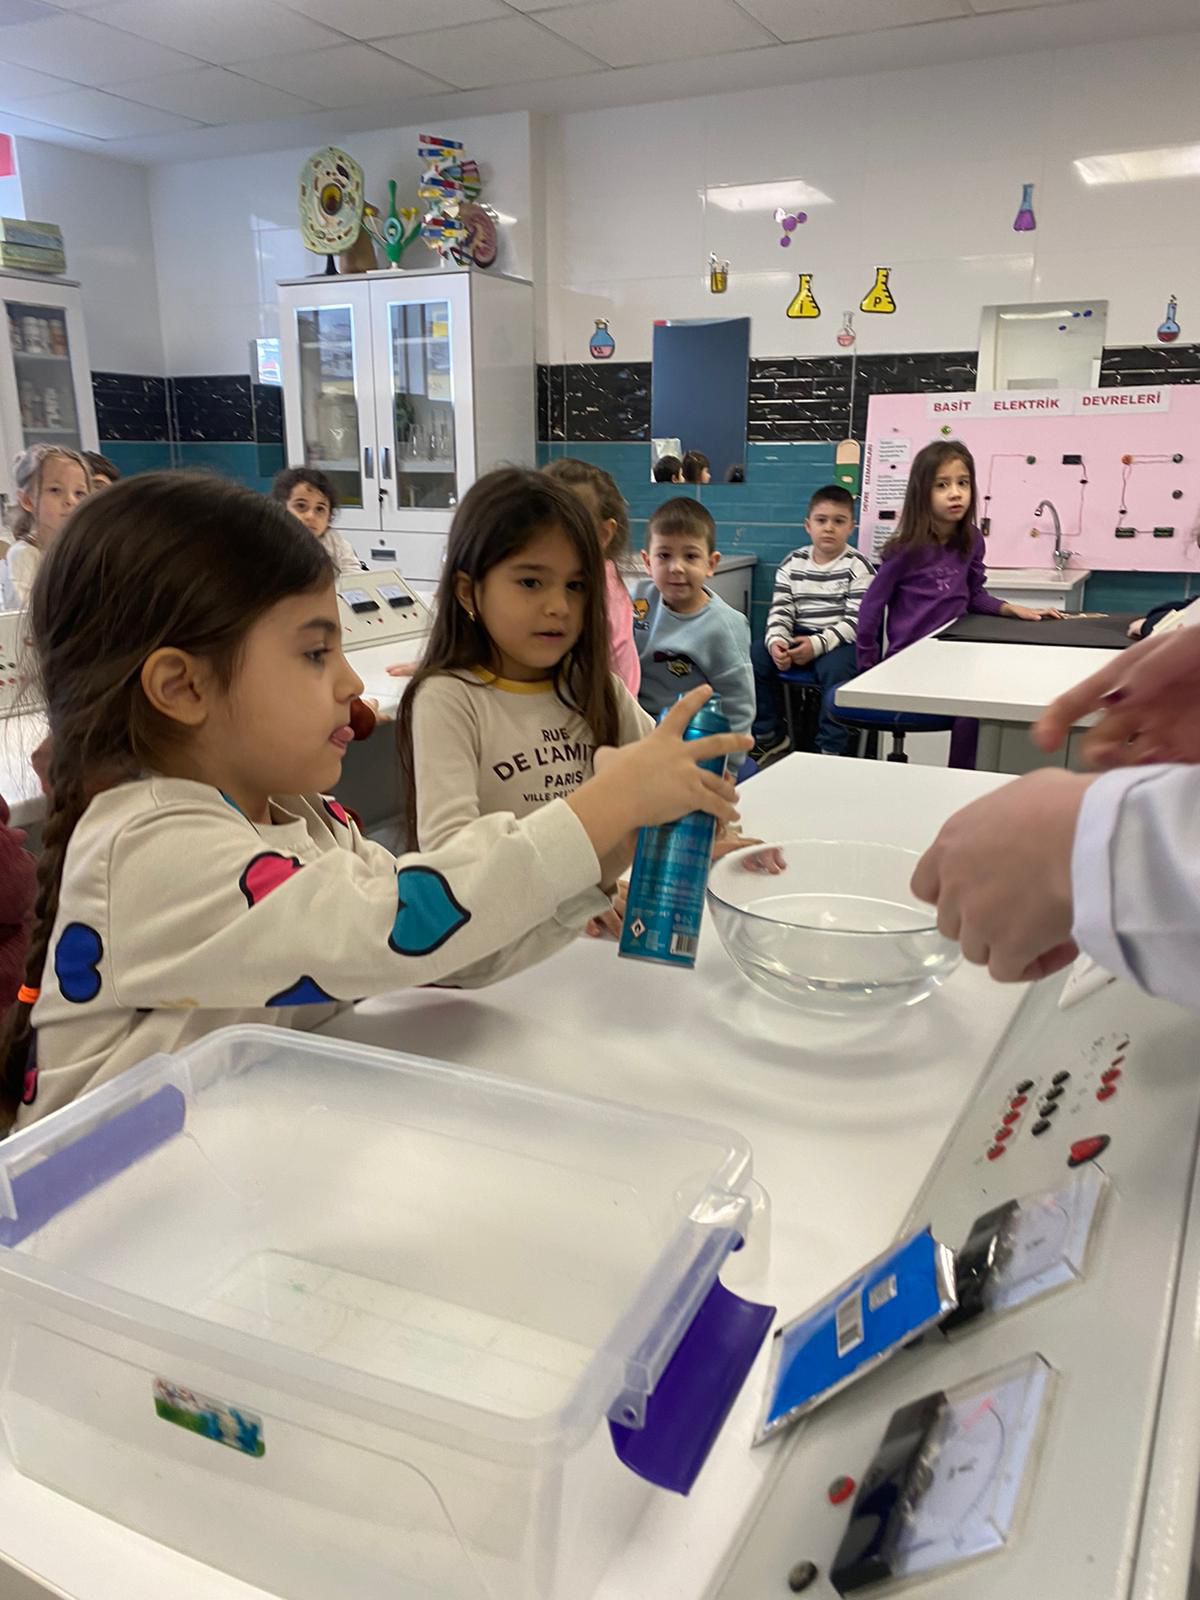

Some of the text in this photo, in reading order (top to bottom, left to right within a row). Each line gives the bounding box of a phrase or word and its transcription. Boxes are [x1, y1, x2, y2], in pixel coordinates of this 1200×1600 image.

[933, 391, 1161, 413] BASİT ELEKTRİK DEVRELERİ
[862, 492, 870, 513] DEVRE
[541, 727, 570, 742] RUE
[492, 752, 531, 782] DE
[544, 770, 584, 788] PARIS
[523, 792, 551, 802] VILLE
